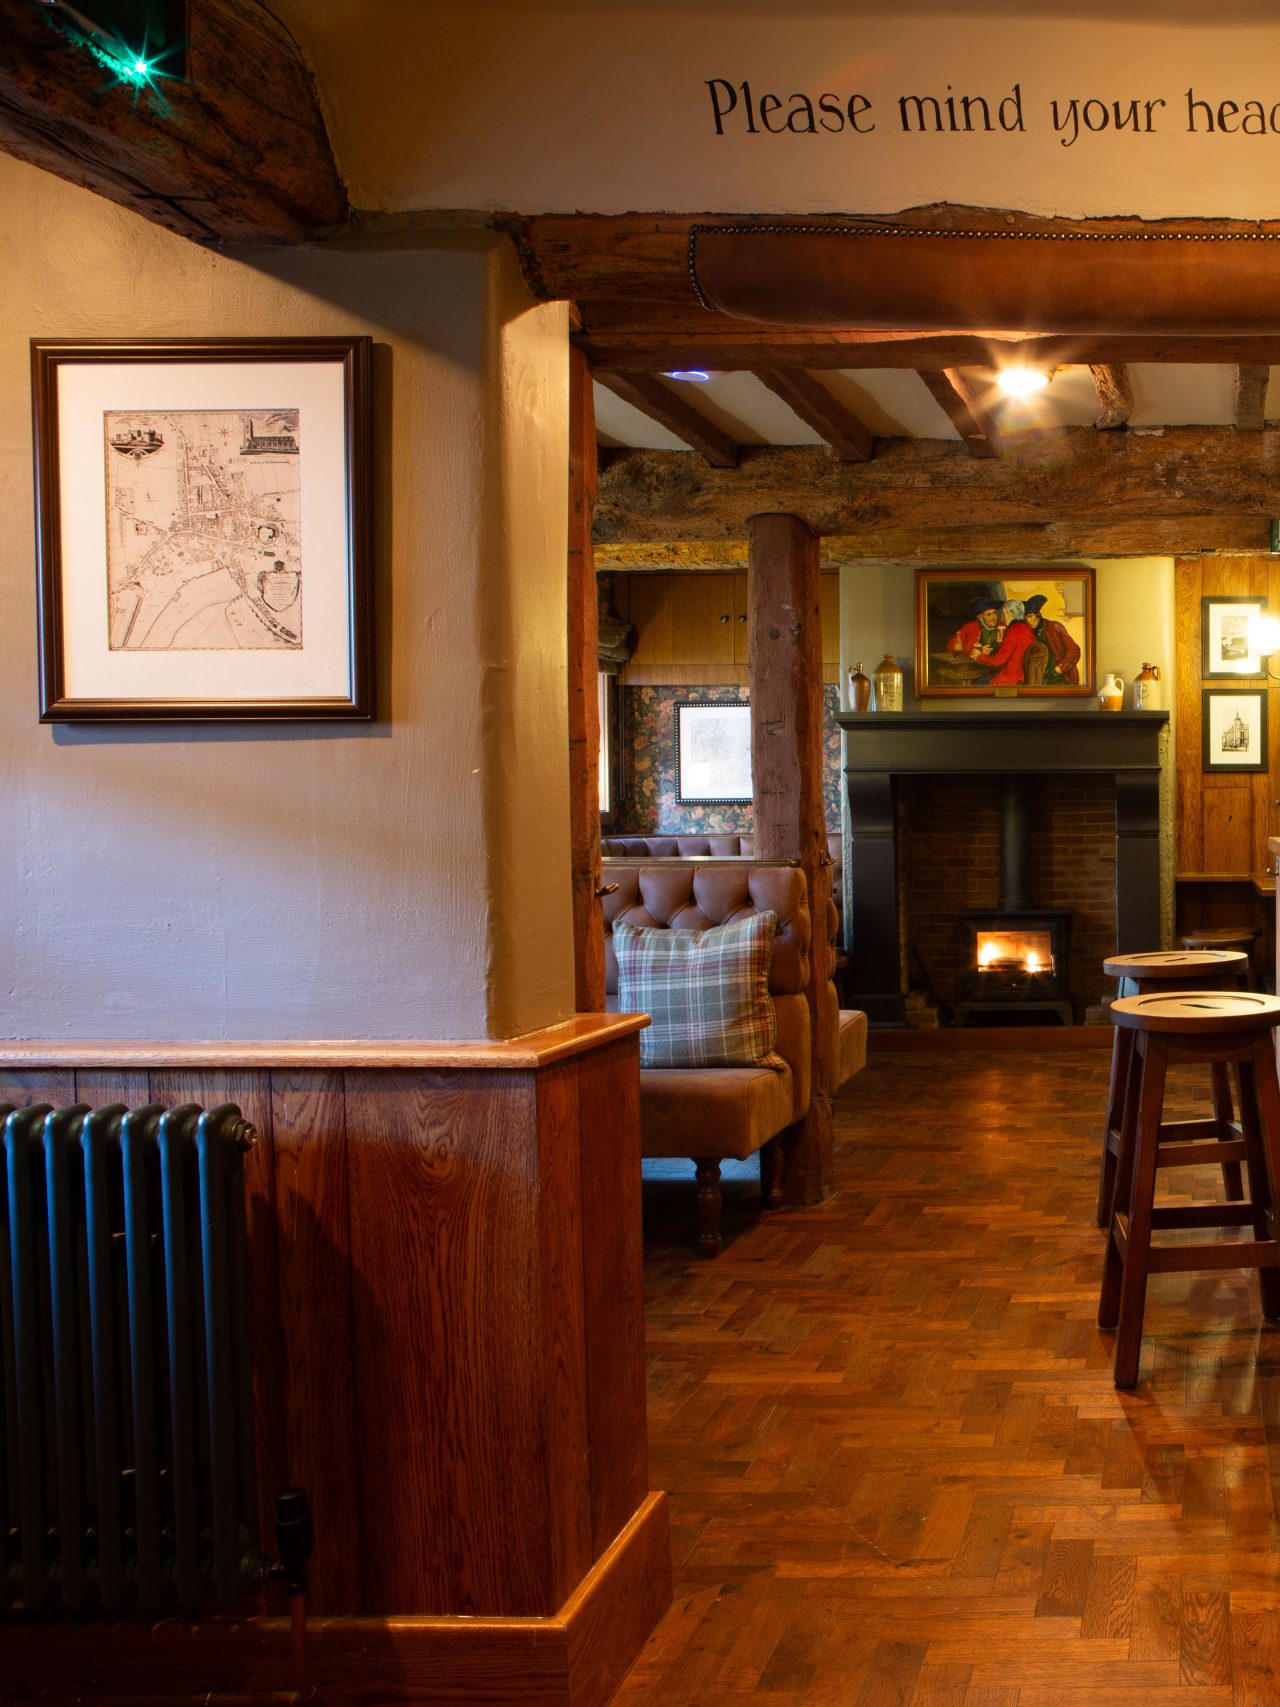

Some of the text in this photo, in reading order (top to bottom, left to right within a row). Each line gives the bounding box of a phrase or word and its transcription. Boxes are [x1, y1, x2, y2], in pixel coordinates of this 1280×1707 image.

[704, 78, 875, 135] Please
[899, 84, 1026, 133] mind
[1051, 96, 1166, 147] your
